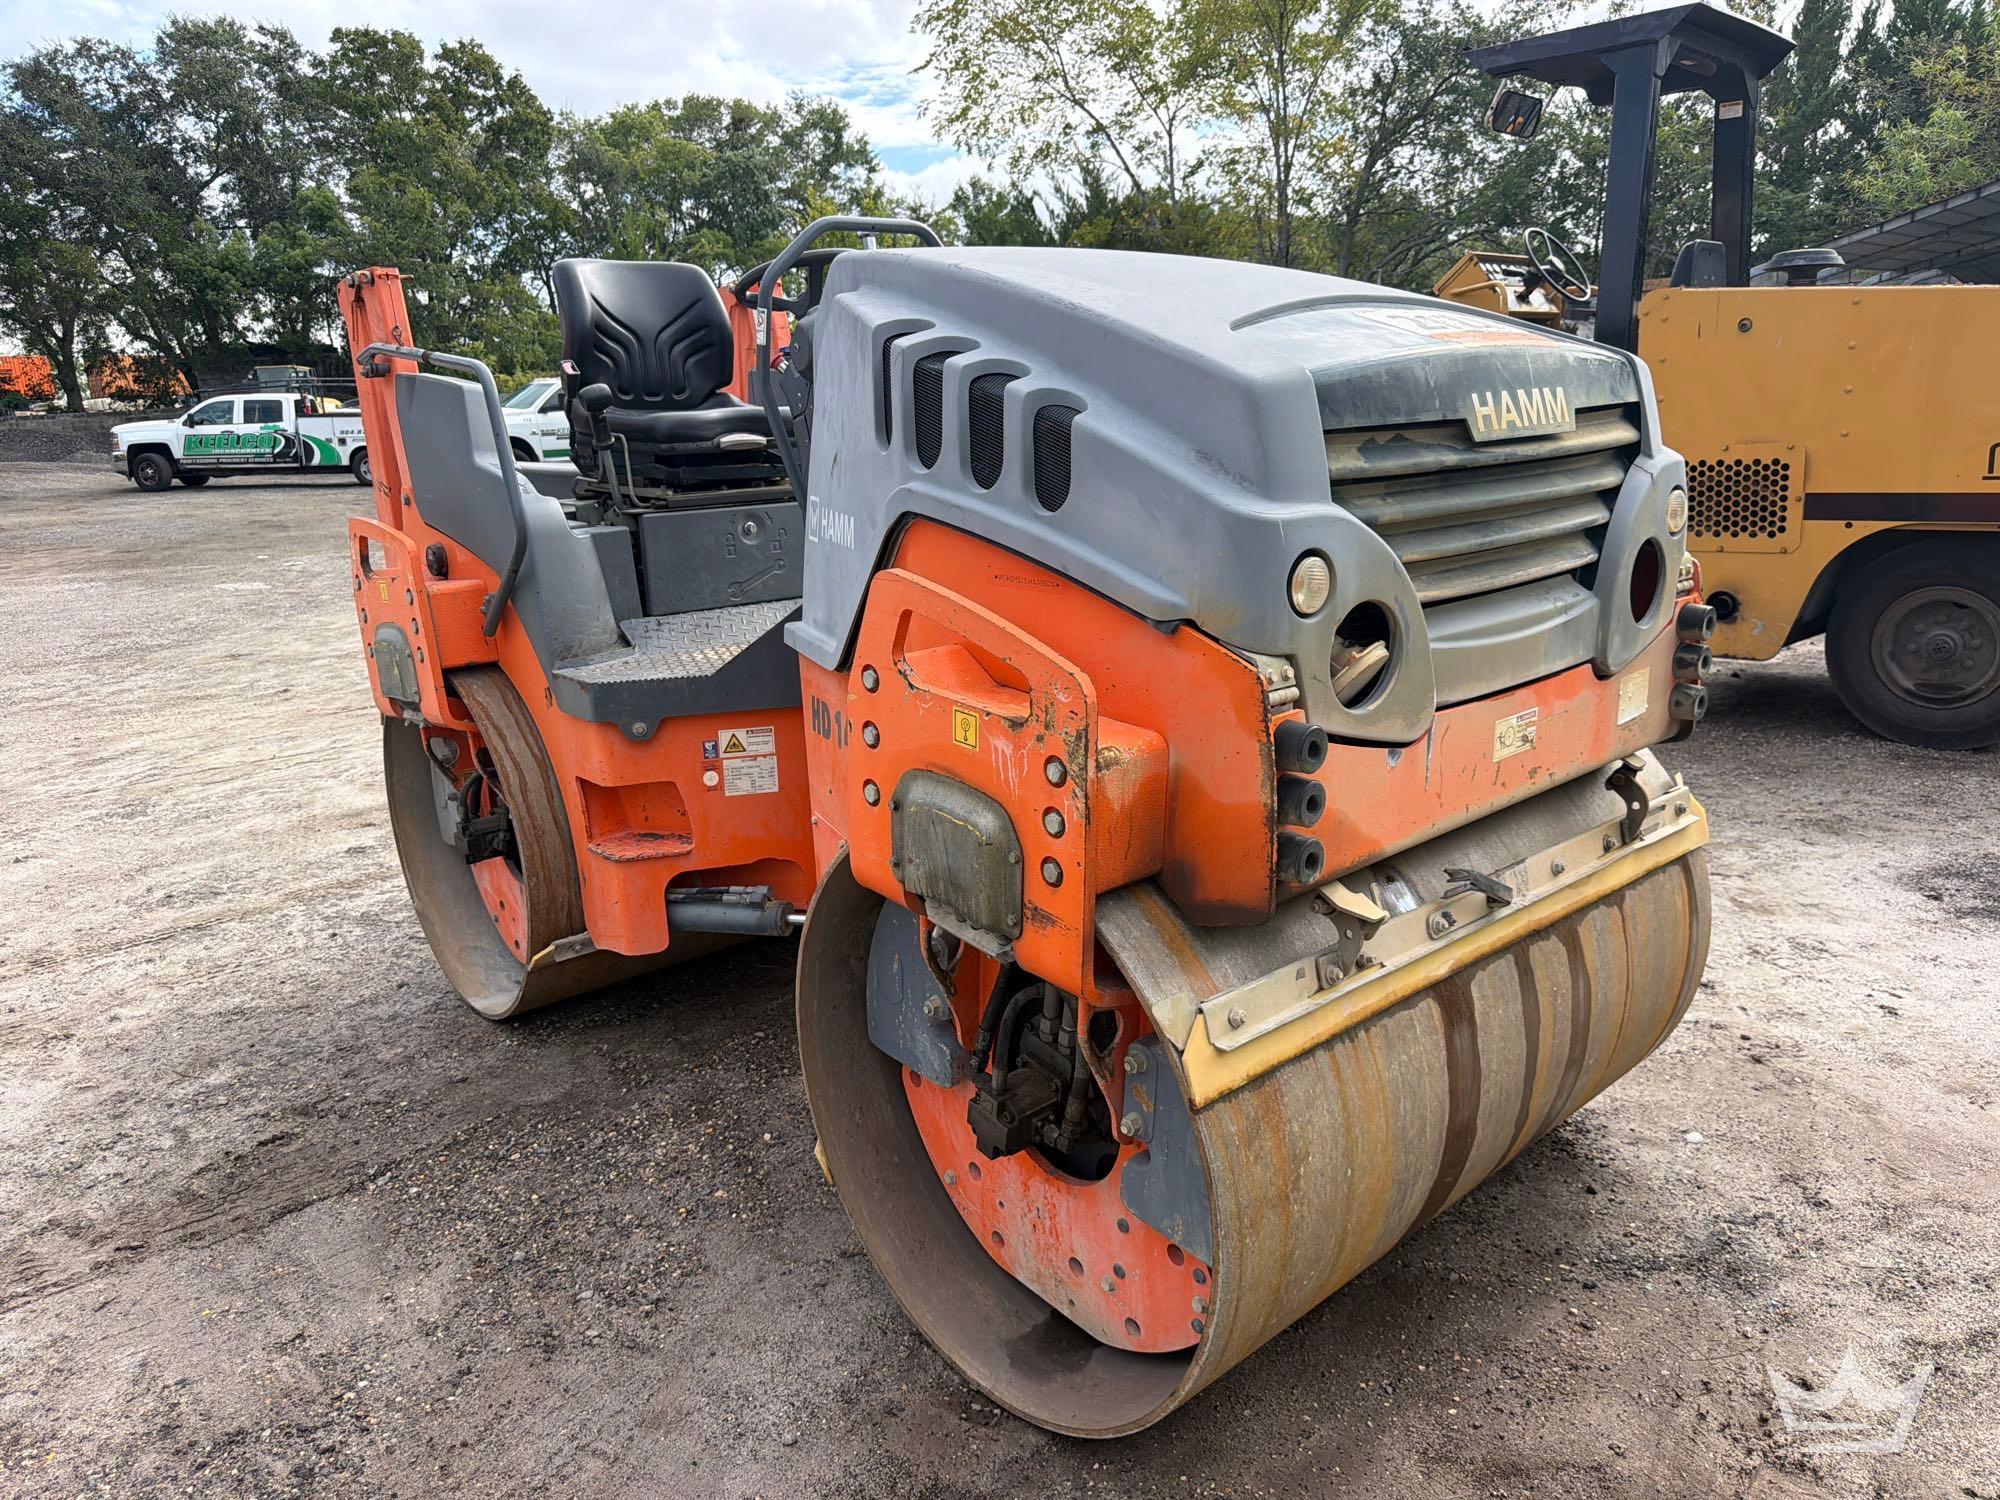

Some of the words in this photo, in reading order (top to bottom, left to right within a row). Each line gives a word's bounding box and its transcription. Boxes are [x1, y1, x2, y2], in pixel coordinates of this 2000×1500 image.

[1471, 386, 1570, 432] HAMM
[185, 433, 274, 450] KEELCO
[821, 506, 855, 550] HAMM
[811, 694, 831, 740] HD
